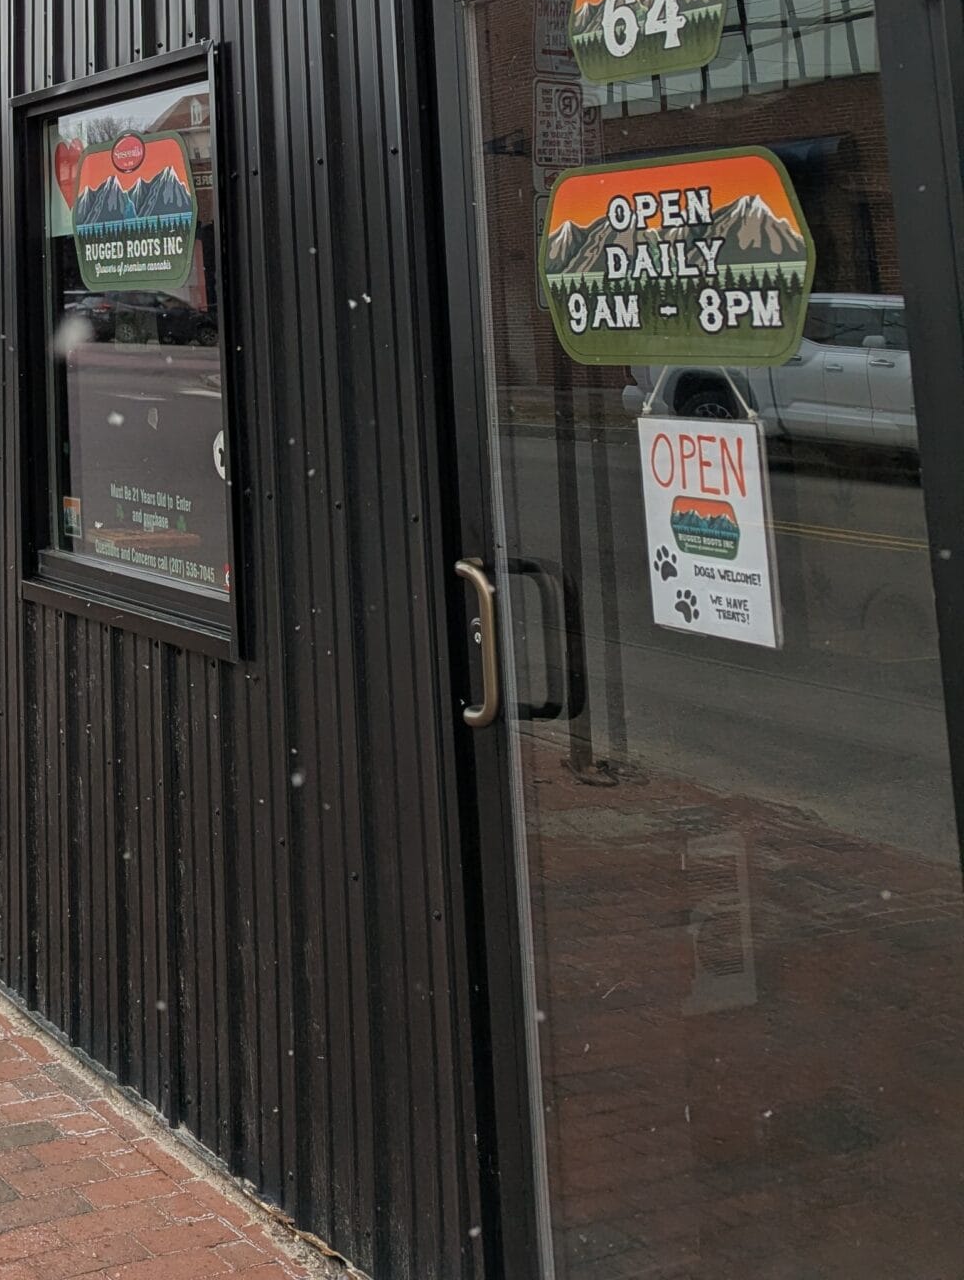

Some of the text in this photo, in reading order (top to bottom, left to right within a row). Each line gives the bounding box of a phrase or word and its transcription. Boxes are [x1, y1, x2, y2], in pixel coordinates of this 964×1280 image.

[607, 186, 713, 232] OPEN
[86, 236, 183, 261] RUGGED ROOTS INC
[604, 238, 725, 280] DAILY
[567, 288, 783, 334] 9AM - 8PM
[651, 433, 746, 498] OPEN
[110, 482, 123, 499] Must
[124, 486, 131, 501] Be
[132, 487, 139, 502] 21
[140, 488, 155, 505] Years
[156, 492, 166, 507] Old
[176, 495, 192, 512] Enter
[132, 509, 169, 532] and purchase
[95, 540, 120, 557] Questions
[120, 547, 130, 561] and
[131, 547, 156, 568] Concerns
[157, 556, 167, 571] call
[169, 557, 185, 577] (207)
[694, 564, 762, 587] DOGS WELCOME!
[709, 594, 749, 611] WE HAVE
[716, 609, 750, 625] TREATS!
